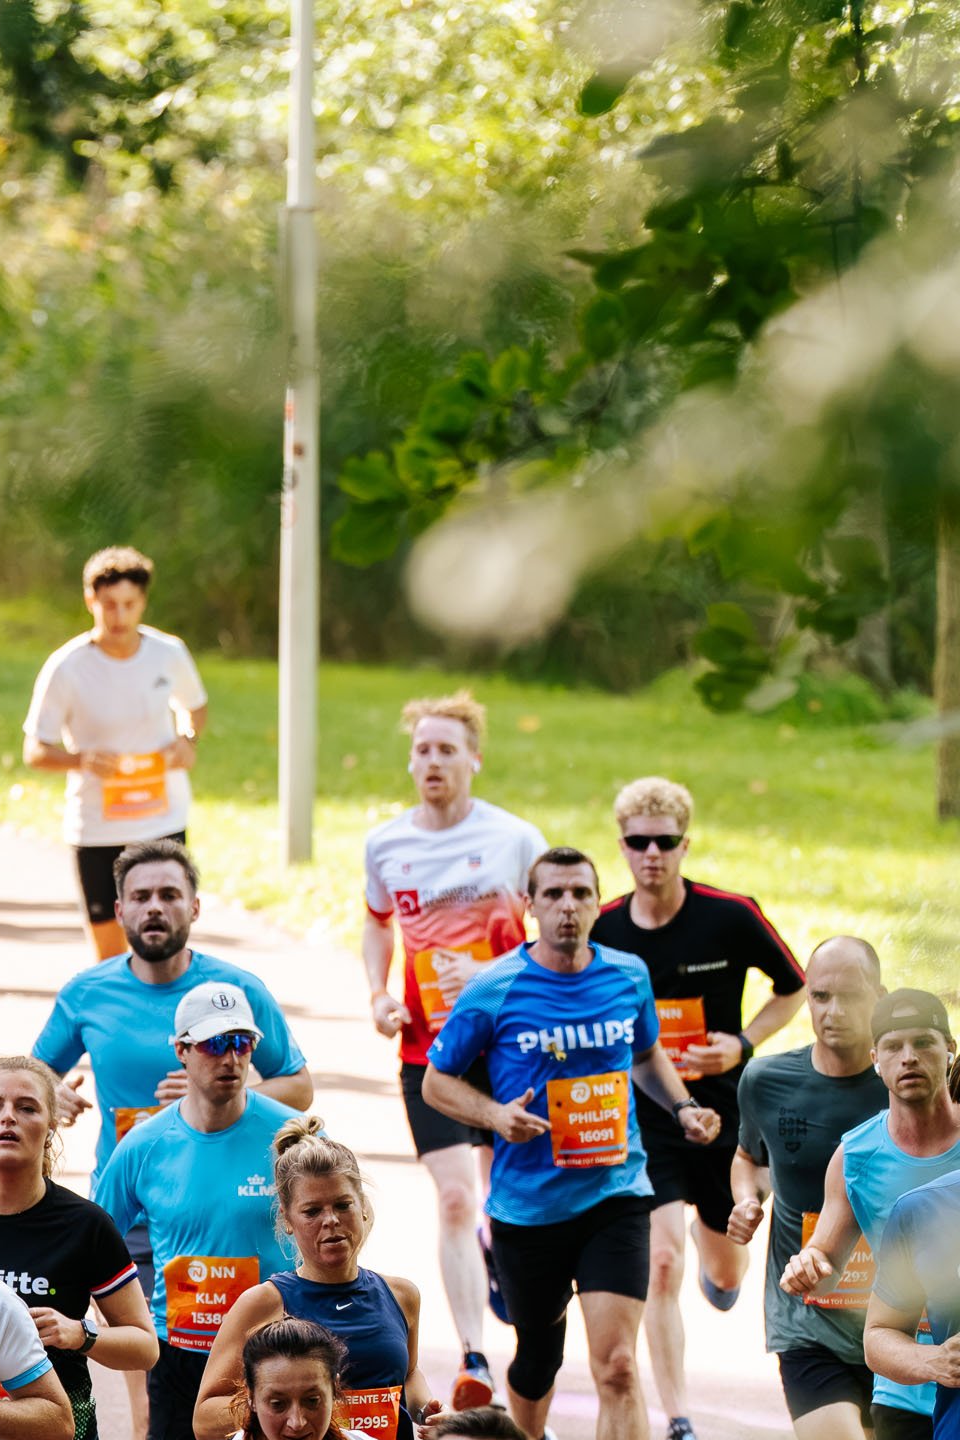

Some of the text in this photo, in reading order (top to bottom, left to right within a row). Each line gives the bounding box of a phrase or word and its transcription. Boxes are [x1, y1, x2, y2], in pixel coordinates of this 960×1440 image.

[219, 994, 229, 1008] B
[517, 1017, 636, 1053] PHILIPS
[593, 1084, 614, 1097] NN
[568, 1107, 620, 1126] PHILIPS
[579, 1127, 614, 1143] 16091
[238, 1185, 276, 1196] KLM
[210, 1266, 235, 1278] NN
[195, 1293, 226, 1304] KLM
[191, 1312, 224, 1324] 1538
[349, 1415, 389, 1430] 12995
